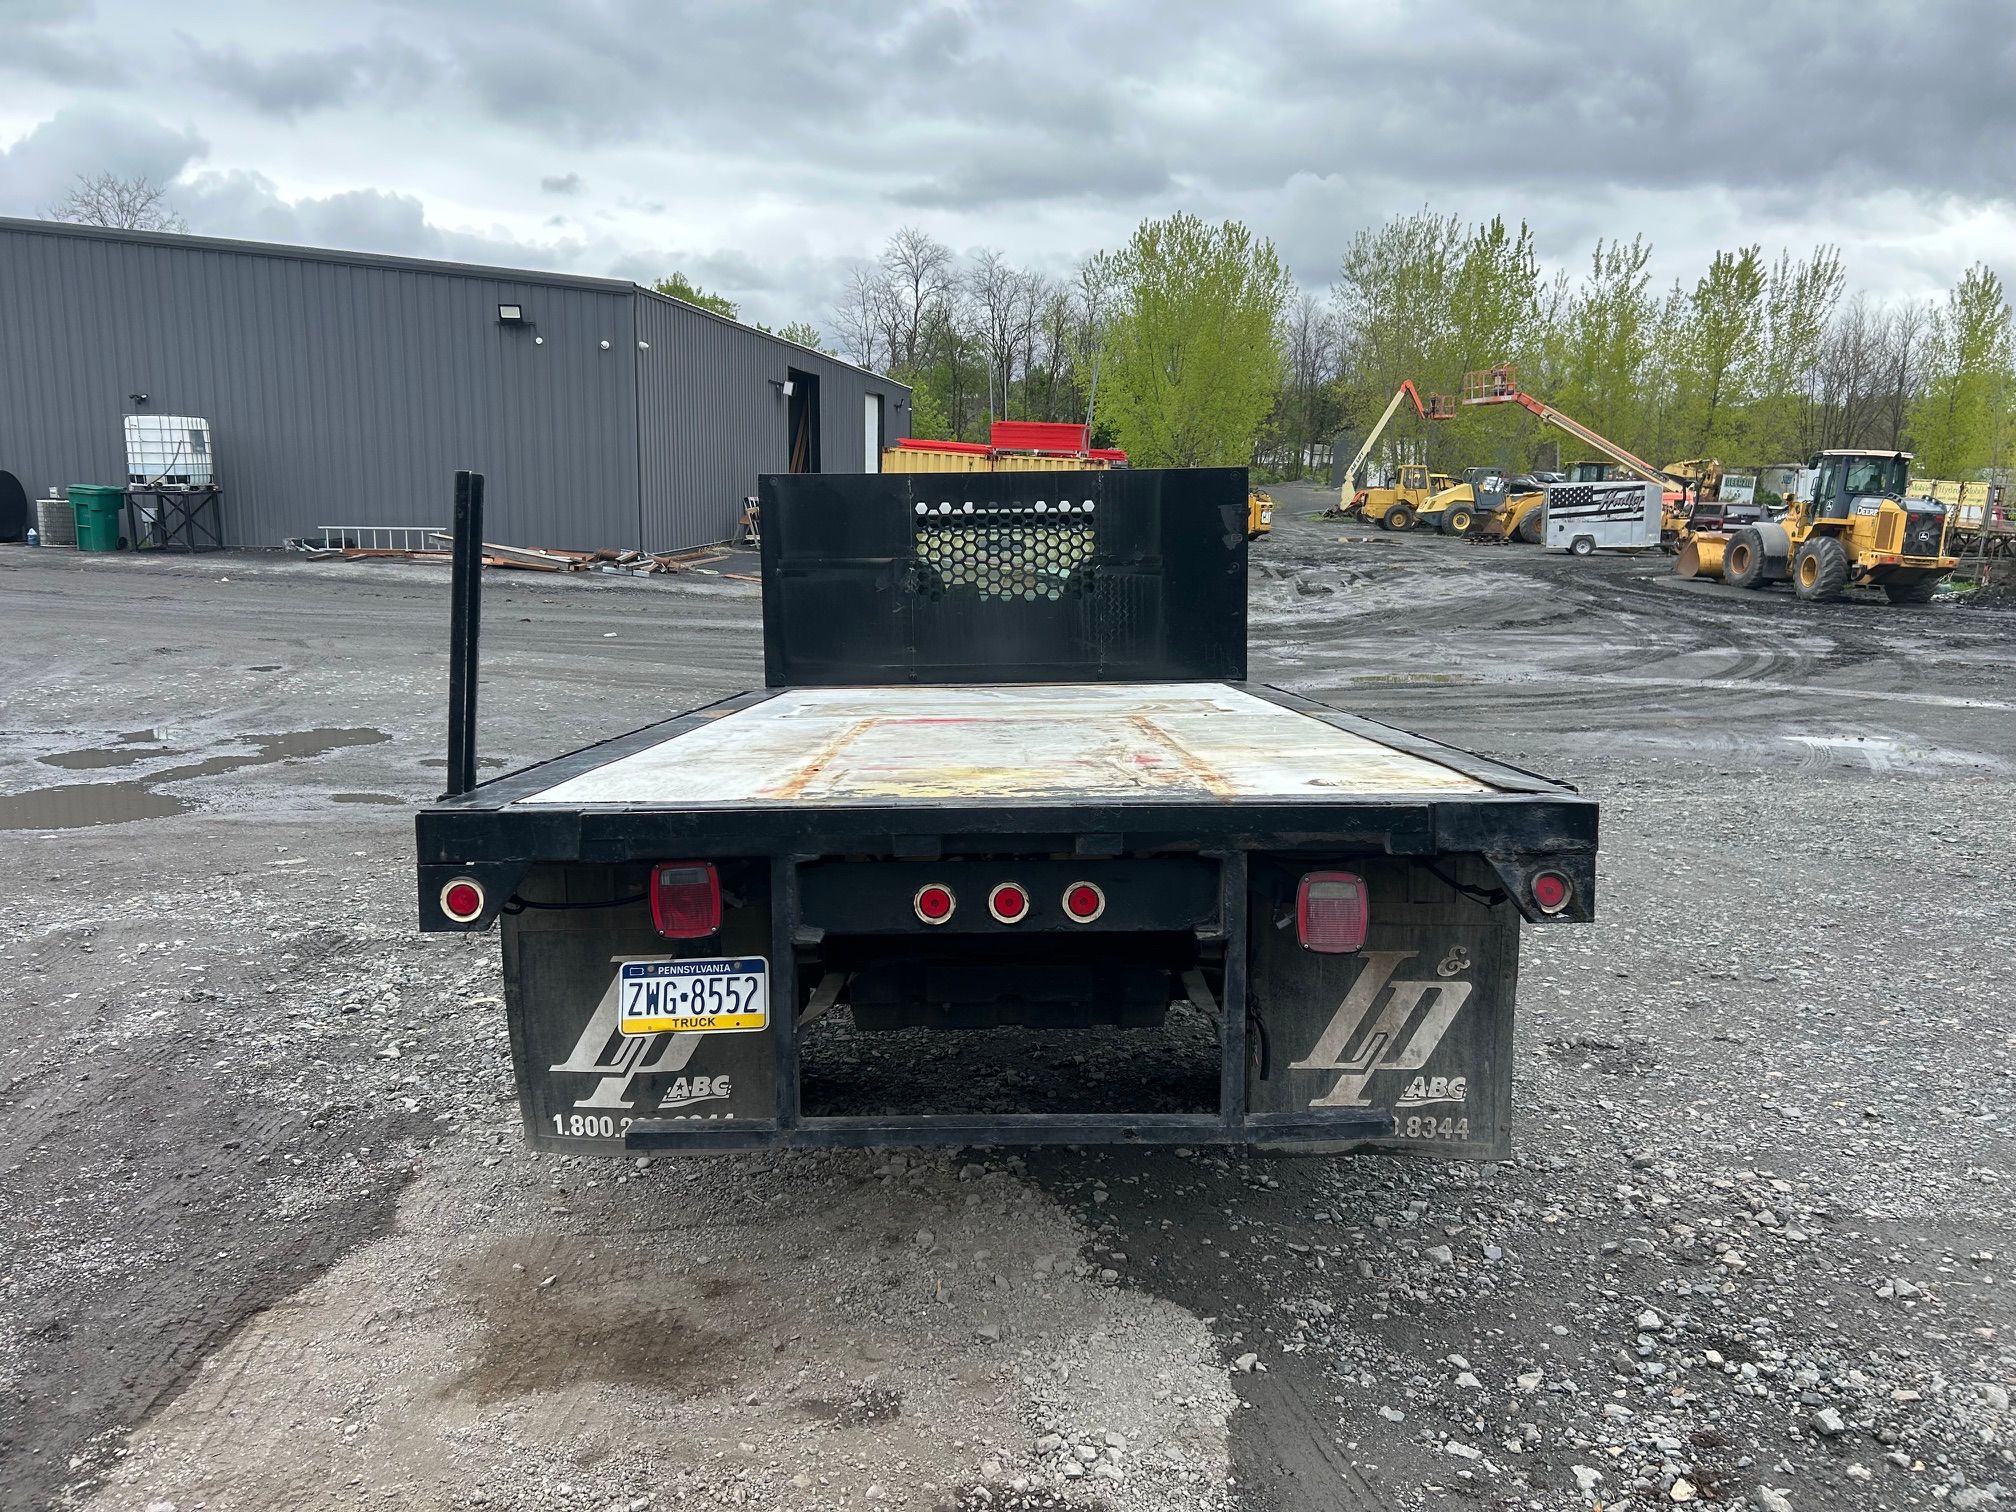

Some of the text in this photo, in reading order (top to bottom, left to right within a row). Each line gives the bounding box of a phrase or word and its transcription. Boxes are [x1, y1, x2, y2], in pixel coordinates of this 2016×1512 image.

[1857, 505, 1879, 516] DEERE
[657, 964, 731, 975] PENNSYLVANIA
[672, 1017, 715, 1028] TRUCK
[665, 1075, 732, 1099] ABC
[1402, 1076, 1468, 1099] ABC
